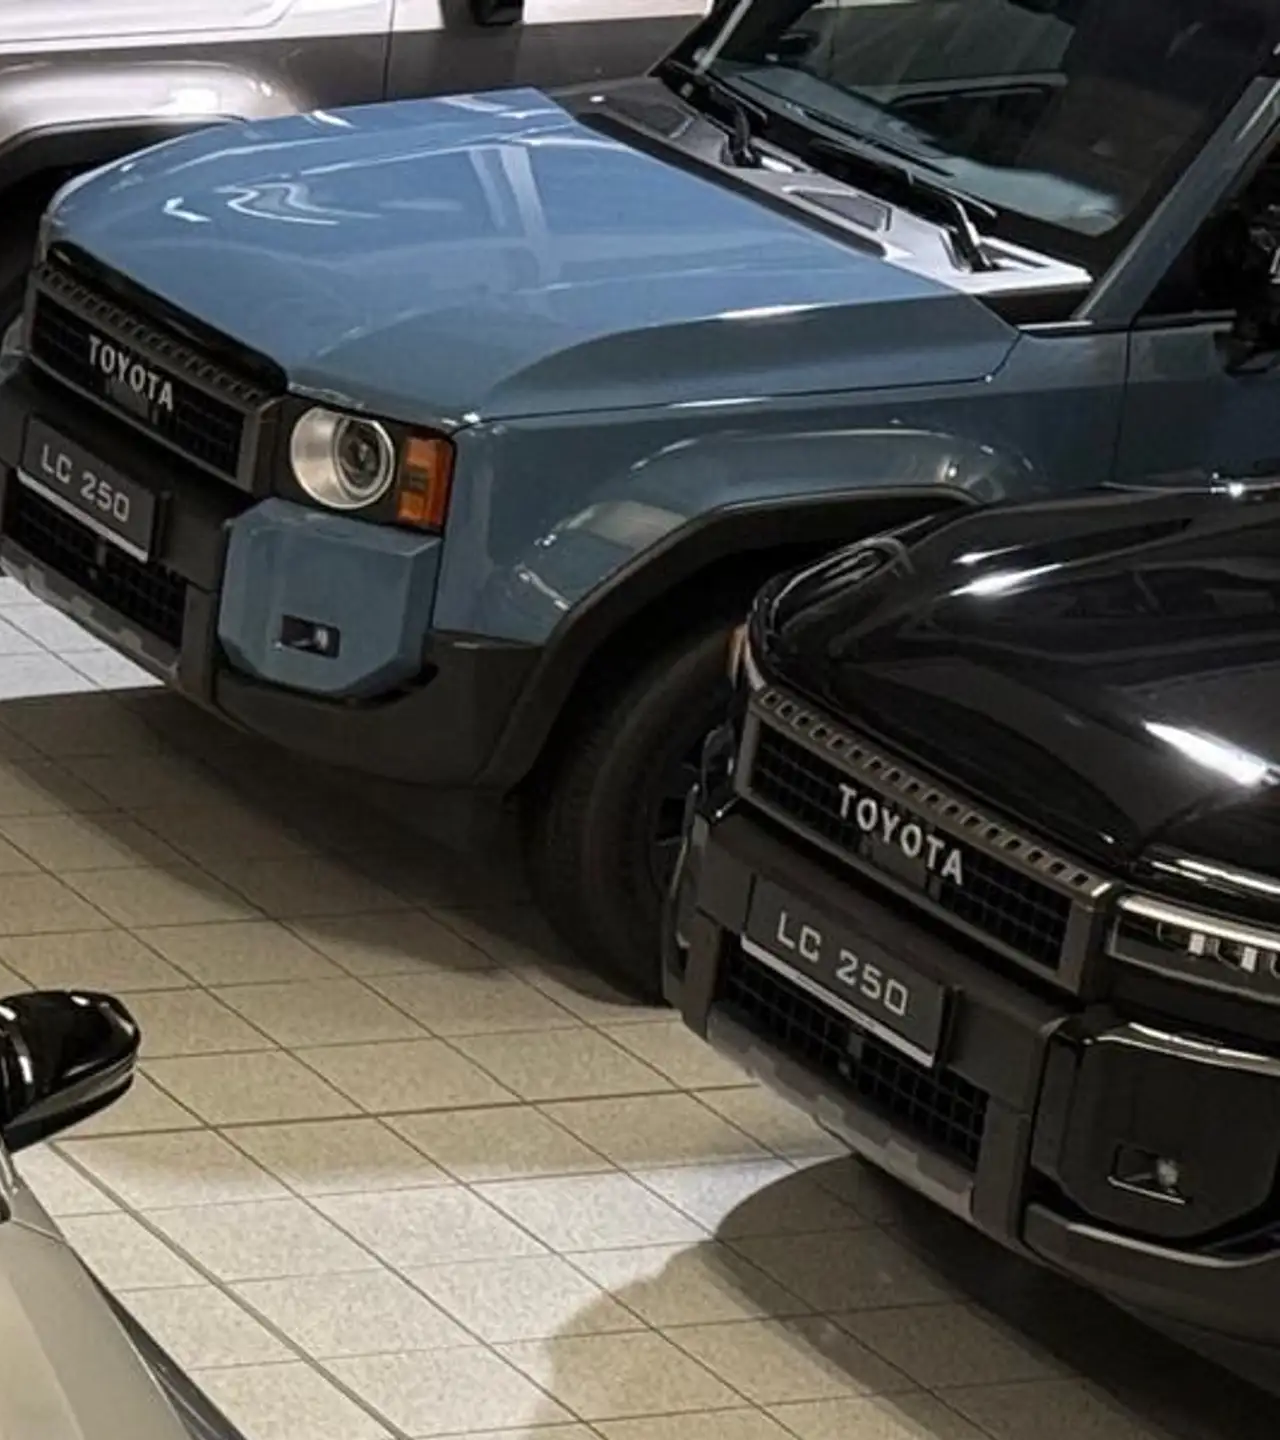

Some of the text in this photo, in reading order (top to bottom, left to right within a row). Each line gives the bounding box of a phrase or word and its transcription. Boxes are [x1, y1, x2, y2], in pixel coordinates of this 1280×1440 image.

[88, 335, 174, 411] TOYOTA
[41, 444, 130, 522] LC 250
[838, 783, 965, 886] TOYOTA
[776, 911, 908, 1017] LC 250
